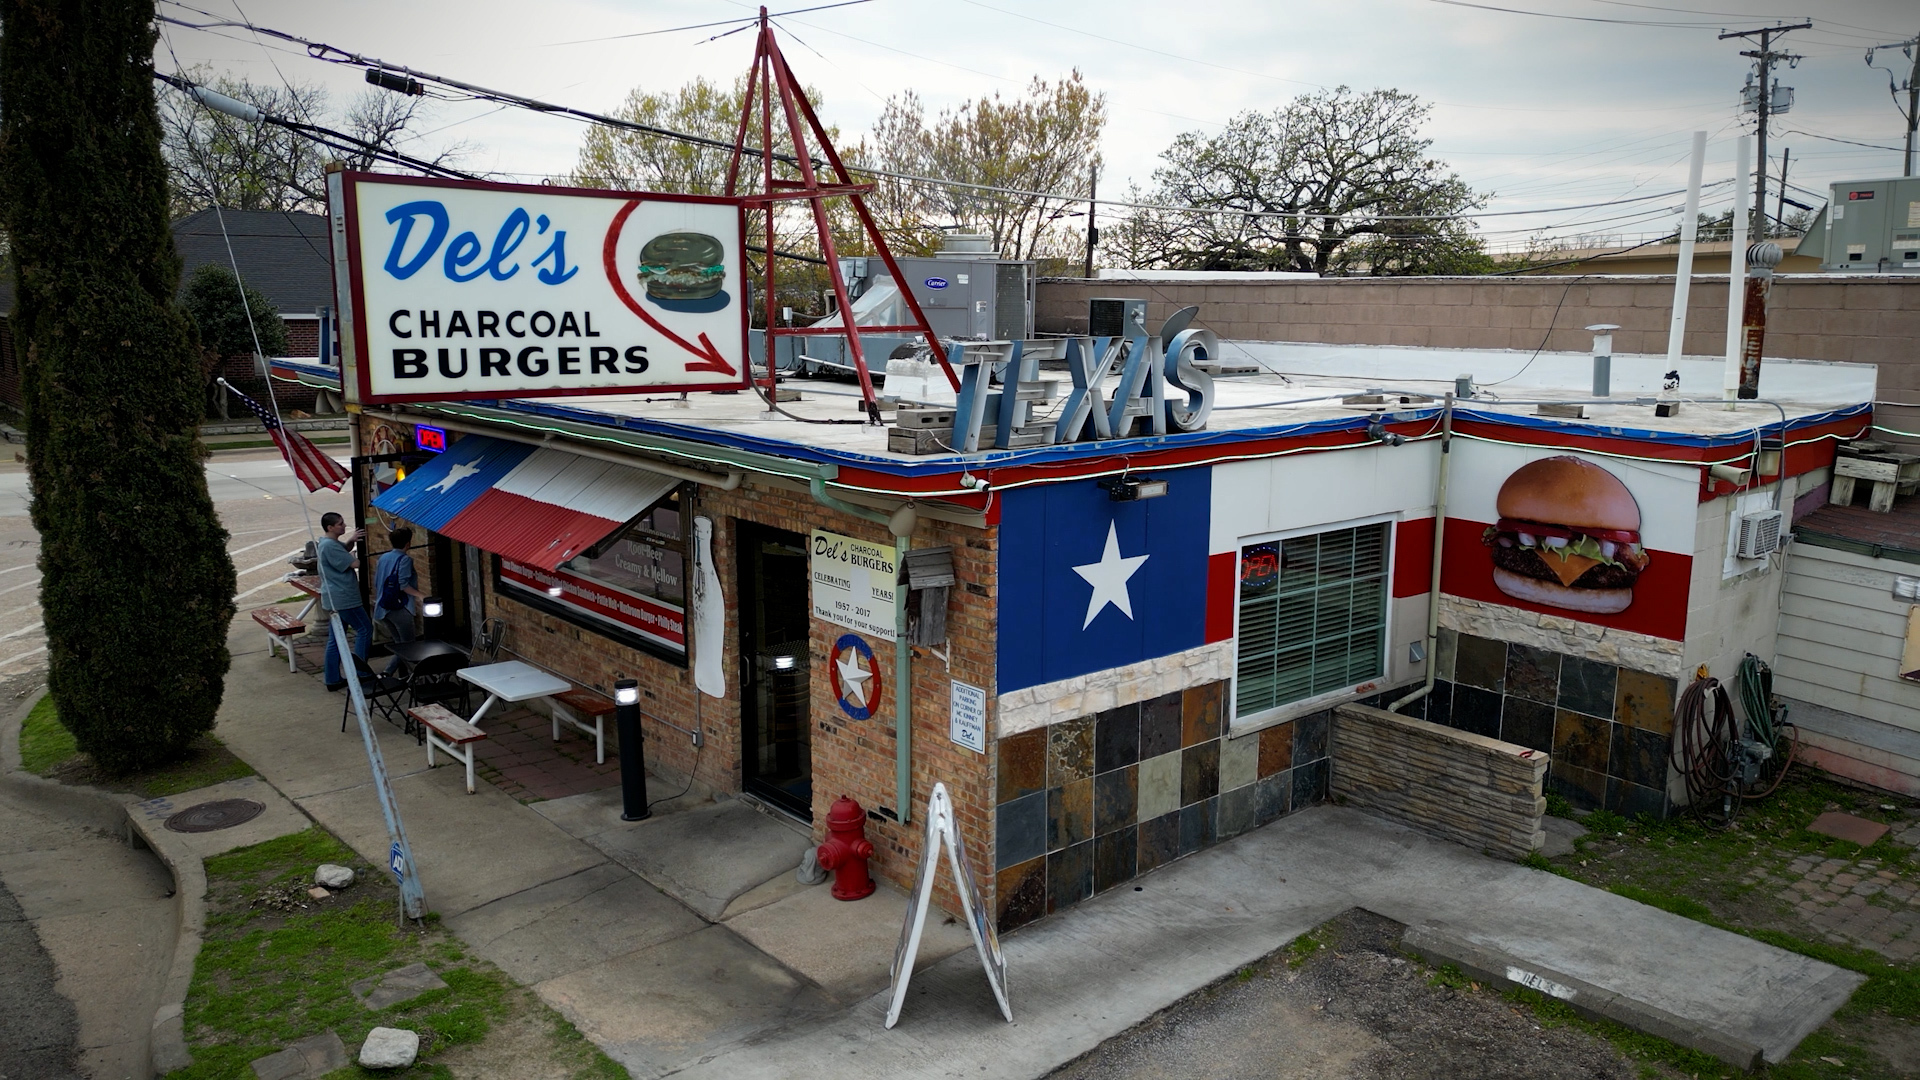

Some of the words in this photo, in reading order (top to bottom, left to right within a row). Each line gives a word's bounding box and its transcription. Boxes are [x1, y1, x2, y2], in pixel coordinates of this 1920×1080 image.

[384, 200, 579, 286] Del's
[927, 279, 946, 287] Carrier
[389, 309, 600, 339] CHARCOAL
[392, 345, 649, 379] BURGERS
[949, 328, 1219, 453] TEXAS
[815, 535, 849, 562] Del's
[850, 543, 884, 559] CHARCOAL
[615, 553, 643, 579] Creamy
[643, 564, 650, 577] &
[651, 564, 678, 586] Mellow
[851, 553, 894, 574] BURGERS
[814, 571, 851, 589] CELEBRATING
[815, 605, 834, 618] Thank
[833, 612, 844, 623] you
[844, 616, 853, 625] for
[854, 619, 868, 628] your
[835, 600, 850, 612] 1957
[855, 606, 871, 618] 2017
[670, 618, 683, 635] Steak
[955, 685, 980, 699] ADDITIONAL
[959, 694, 977, 706] PARKING
[960, 702, 976, 714] CORNER
[393, 854, 404, 874] AD
